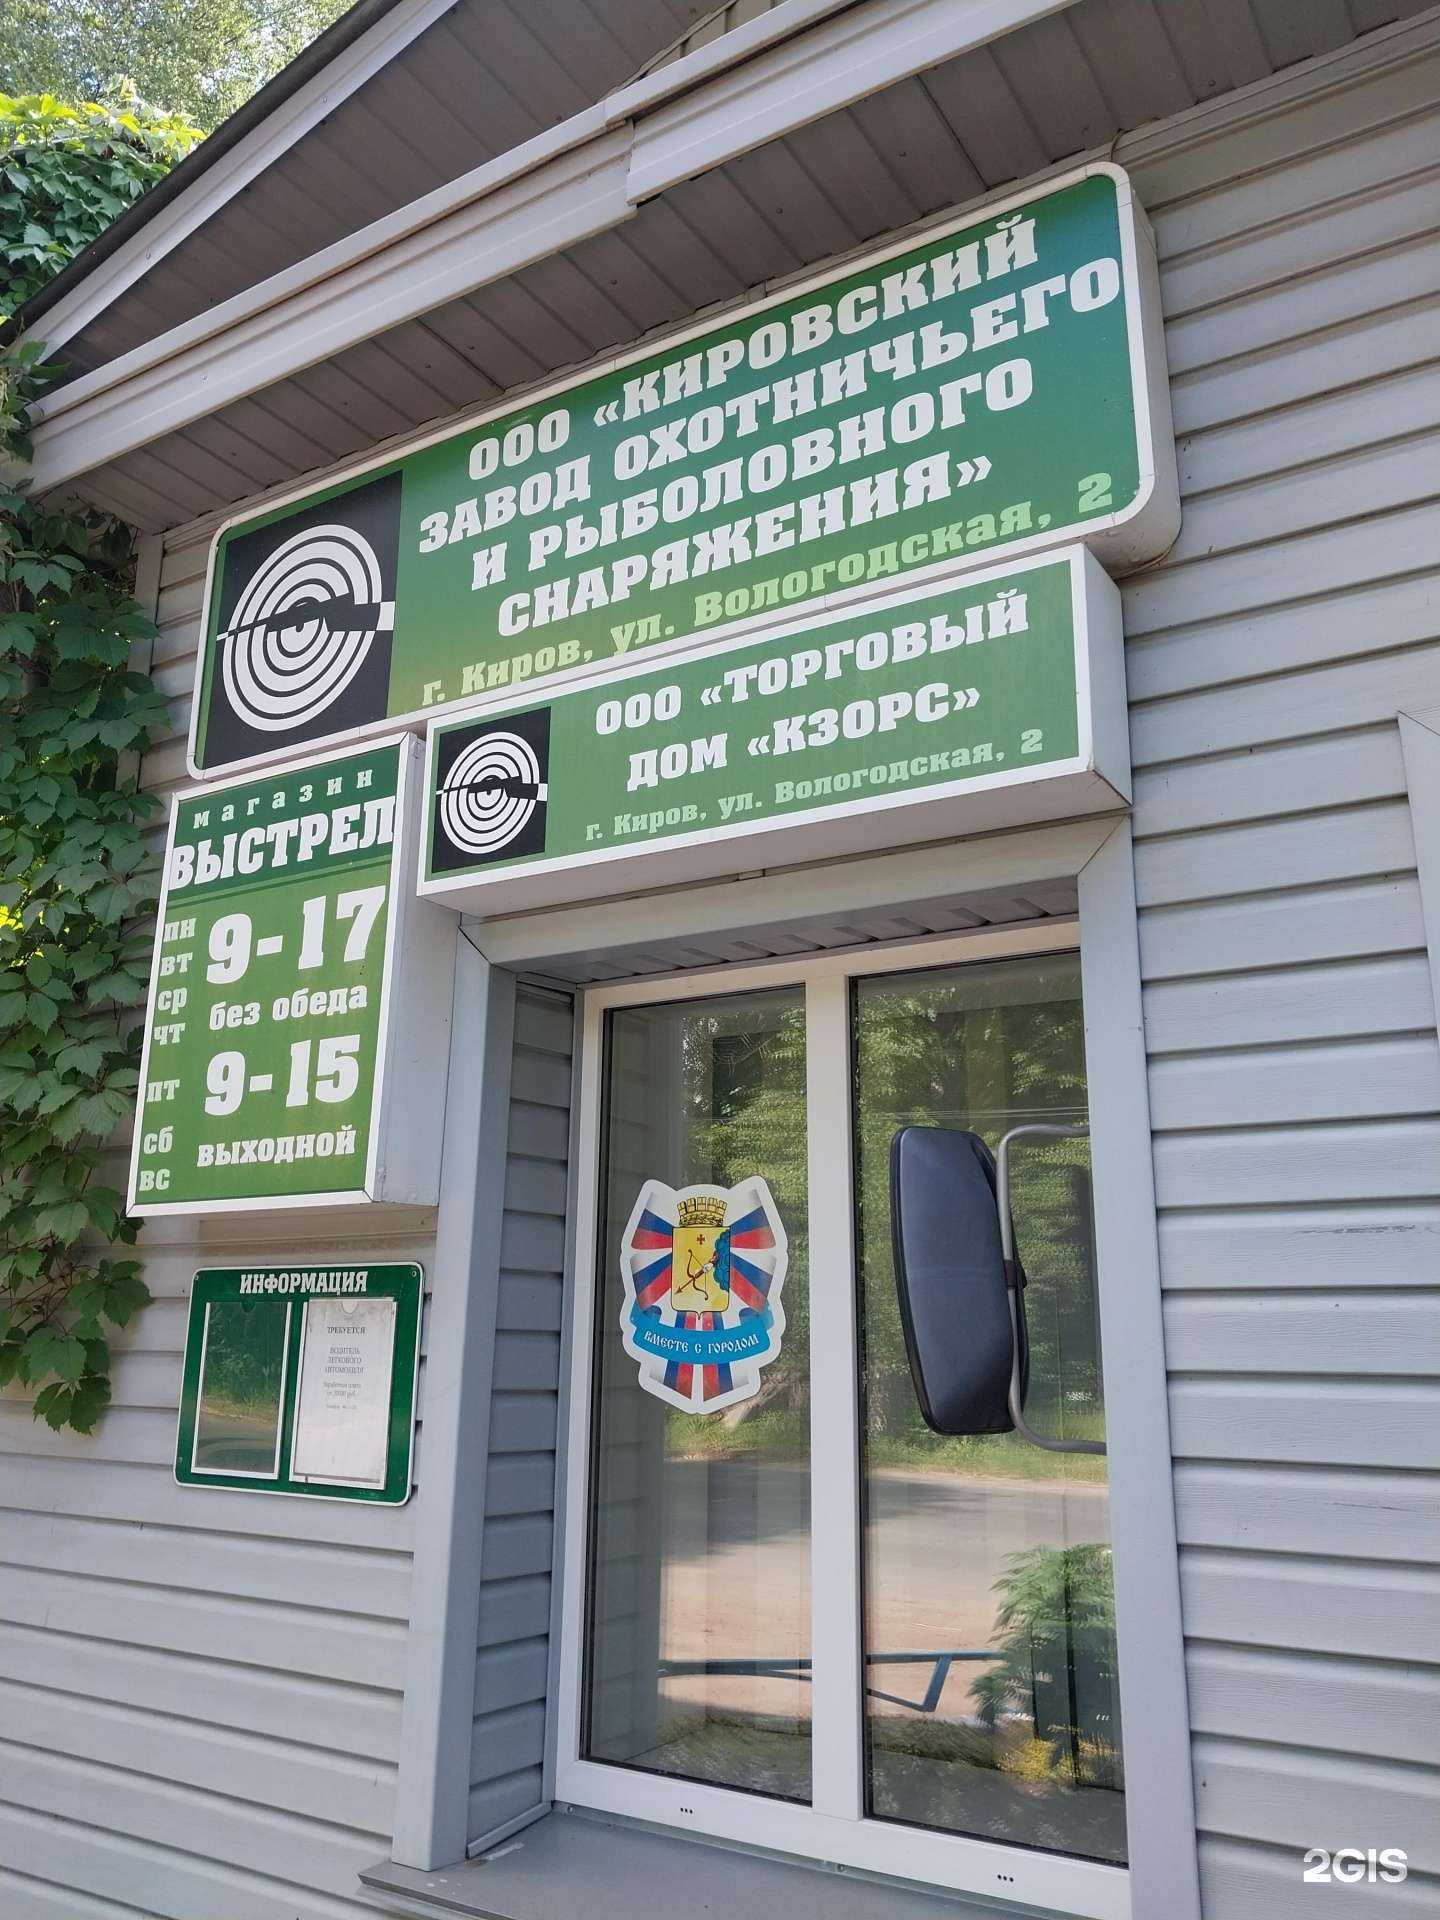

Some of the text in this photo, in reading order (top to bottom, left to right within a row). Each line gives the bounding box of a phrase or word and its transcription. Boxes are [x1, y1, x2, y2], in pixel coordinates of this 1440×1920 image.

[468, 215, 1039, 481] ООО «КИРОВСКИЙ
[419, 256, 1121, 554] ЗАВОД ОХОТНИЧЬЕГО
[471, 357, 1034, 591] И РЫБОЛОВНОГО
[498, 450, 992, 637] СНАРЯЖЕНИЯ»
[422, 472, 1113, 706] г. Киров, ул. Вологодская, 2
[596, 588, 1029, 736] ООО «ТОРГОВЫЙ
[627, 681, 981, 792] ДОМ «КЗОРС»
[585, 728, 1043, 841] г. Киров, ул. Вологодская, 2
[167, 795, 396, 891] ВЫСТРЕЛ
[162, 917, 197, 943] пн
[160, 952, 193, 977] вт
[158, 986, 188, 1016] ср
[209, 985, 368, 1031] без обеда
[153, 1022, 185, 1046] чт
[146, 1078, 180, 1103] пт
[144, 1127, 173, 1155] сб
[197, 1124, 357, 1168] выходной
[139, 1168, 170, 1193] вс
[240, 1271, 368, 1295] ИНФОРМАЦИЯ
